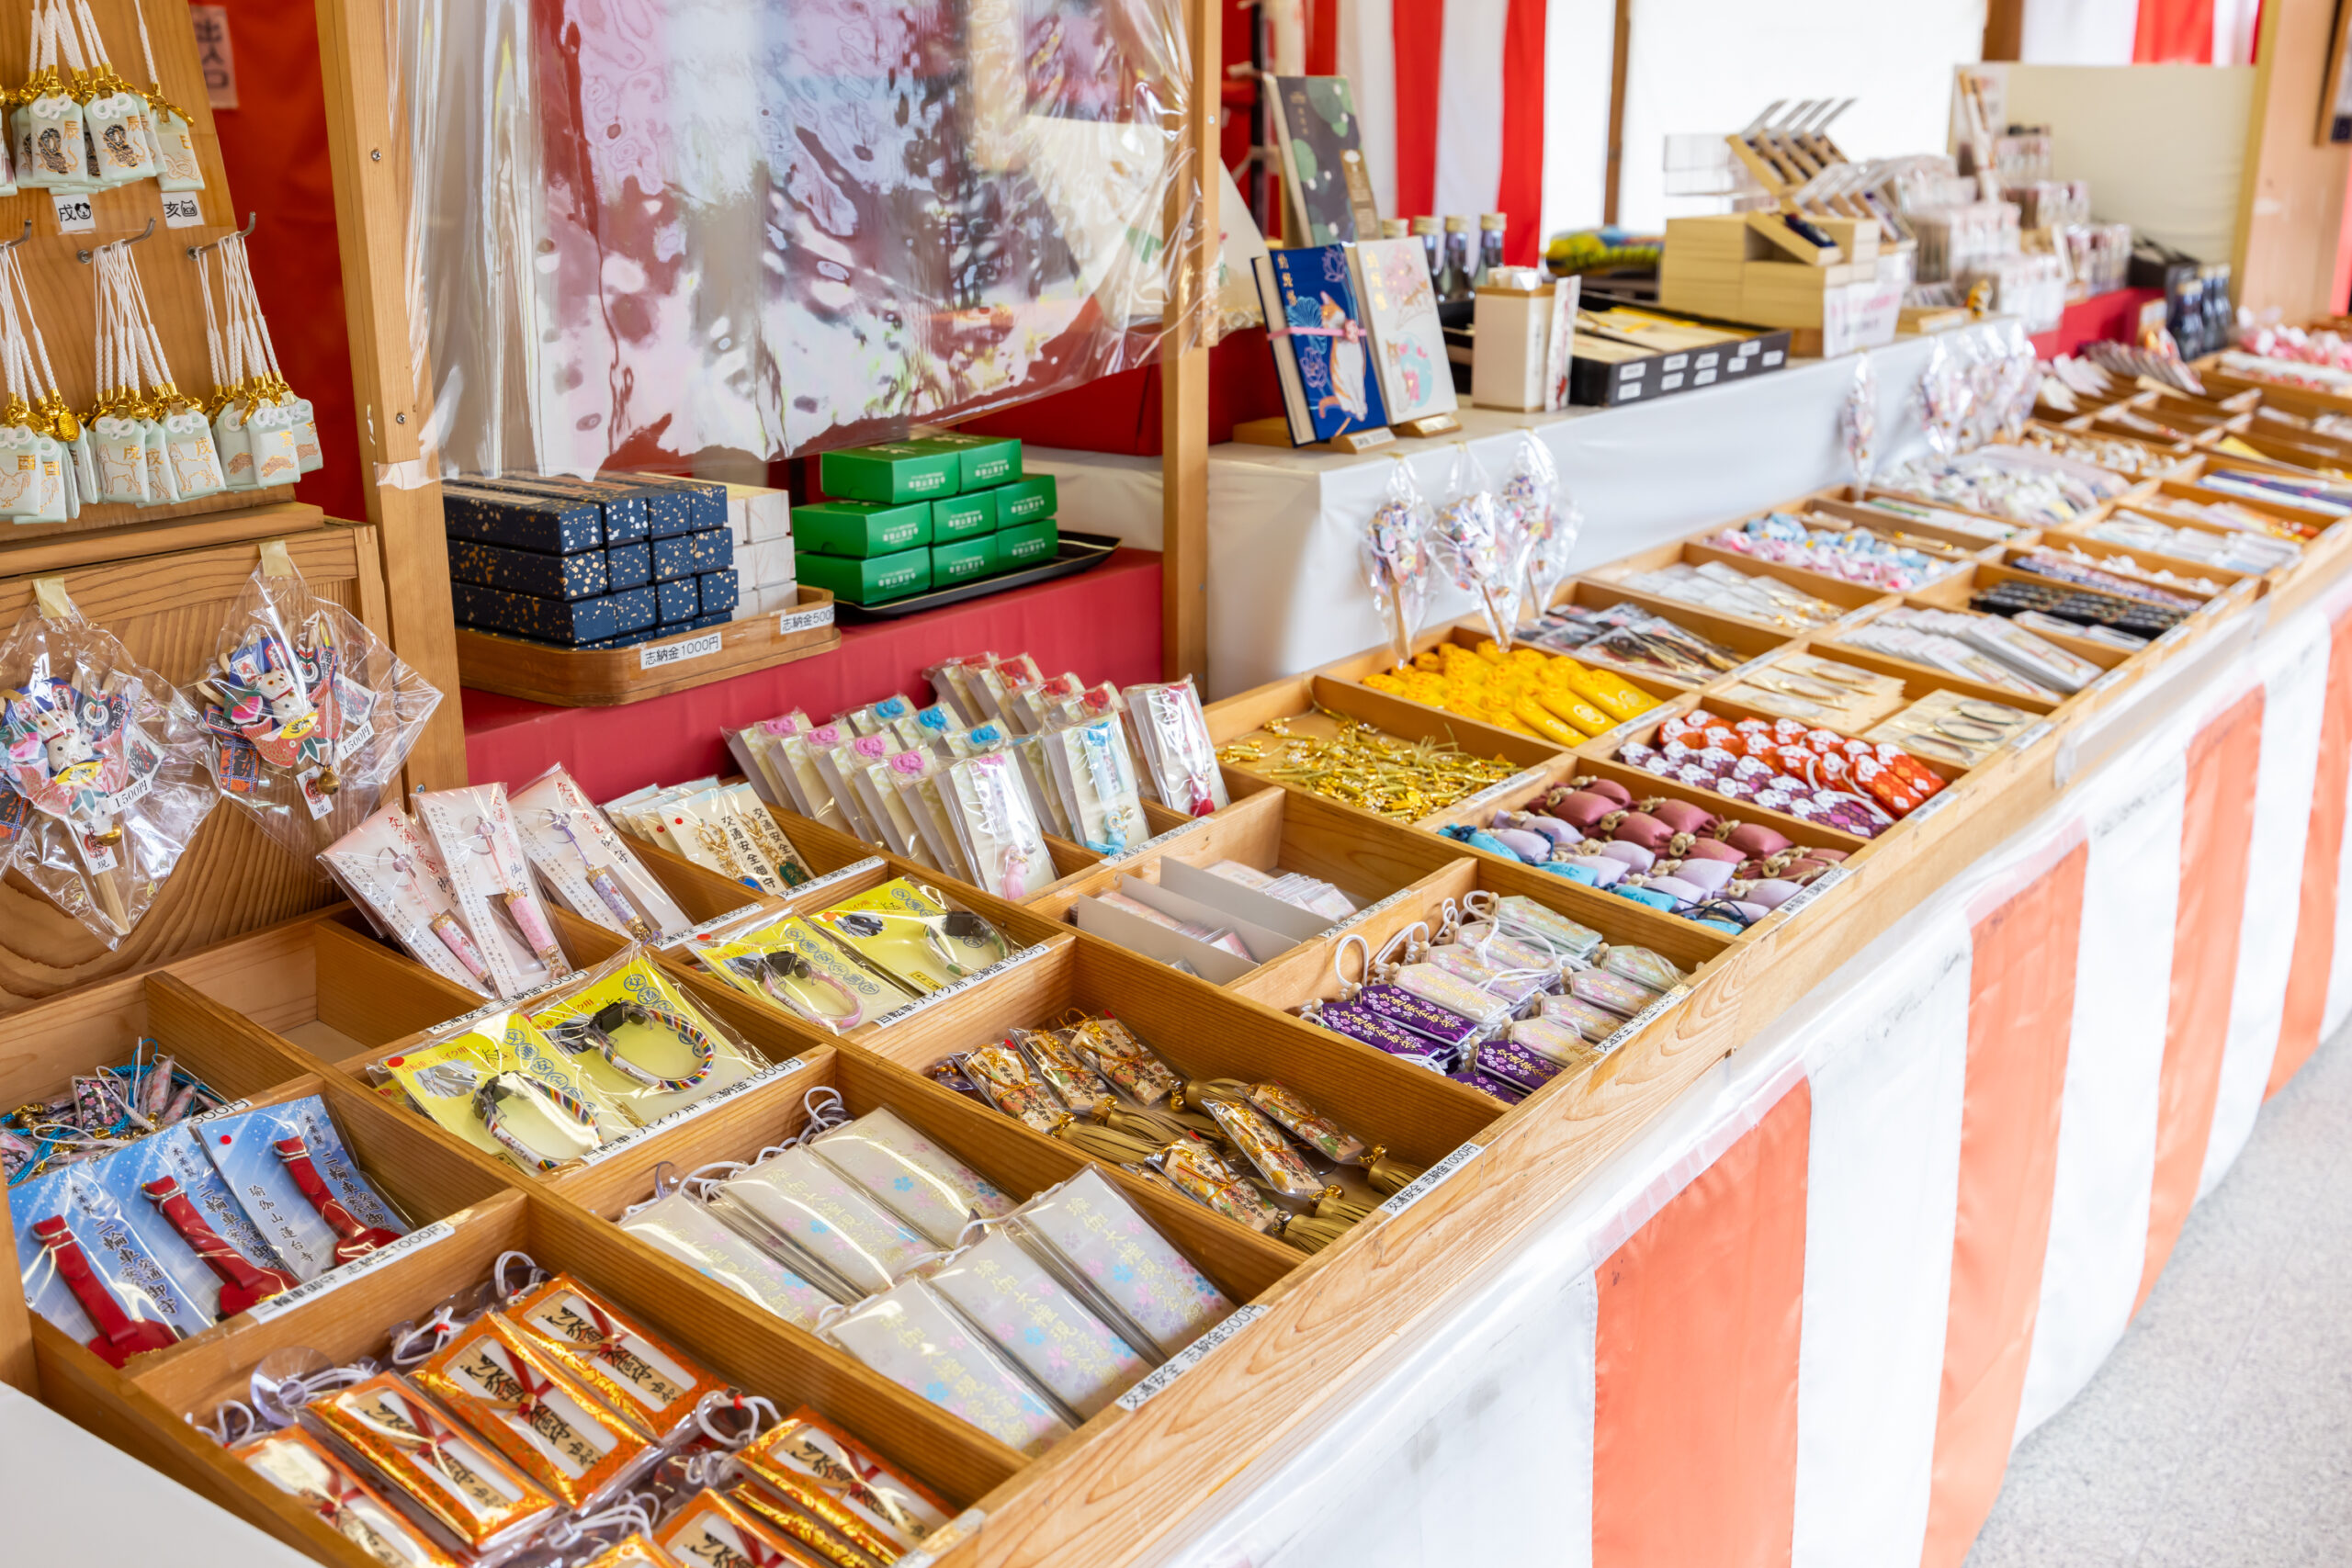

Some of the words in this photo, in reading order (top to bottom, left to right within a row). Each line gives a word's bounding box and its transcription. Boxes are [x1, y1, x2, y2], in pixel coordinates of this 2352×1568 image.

[63, 120, 81, 140] 辰
[58, 204, 77, 222] 戌
[164, 201, 182, 219] 亥
[17, 454, 36, 471] 酉
[123, 445, 142, 460] 戌
[644, 635, 719, 666] 志納金1000円
[342, 725, 370, 755] 1500円
[114, 780, 149, 808] 1500円
[720, 815, 776, 889] 交通安全御守
[322, 1151, 359, 1195] 二輪車
[1385, 1183, 1426, 1212] 交通安全
[1419, 1144, 1478, 1186] 志納金1000円
[196, 1183, 240, 1227] 二輪車
[248, 1184, 316, 1263] 瑜伽山蓮台寺
[94, 1219, 140, 1266] 二輪車
[344, 1223, 448, 1275] 志納金1000円
[1120, 1362, 1185, 1408] 交通安全
[1180, 1304, 1265, 1363] 志納金500円
